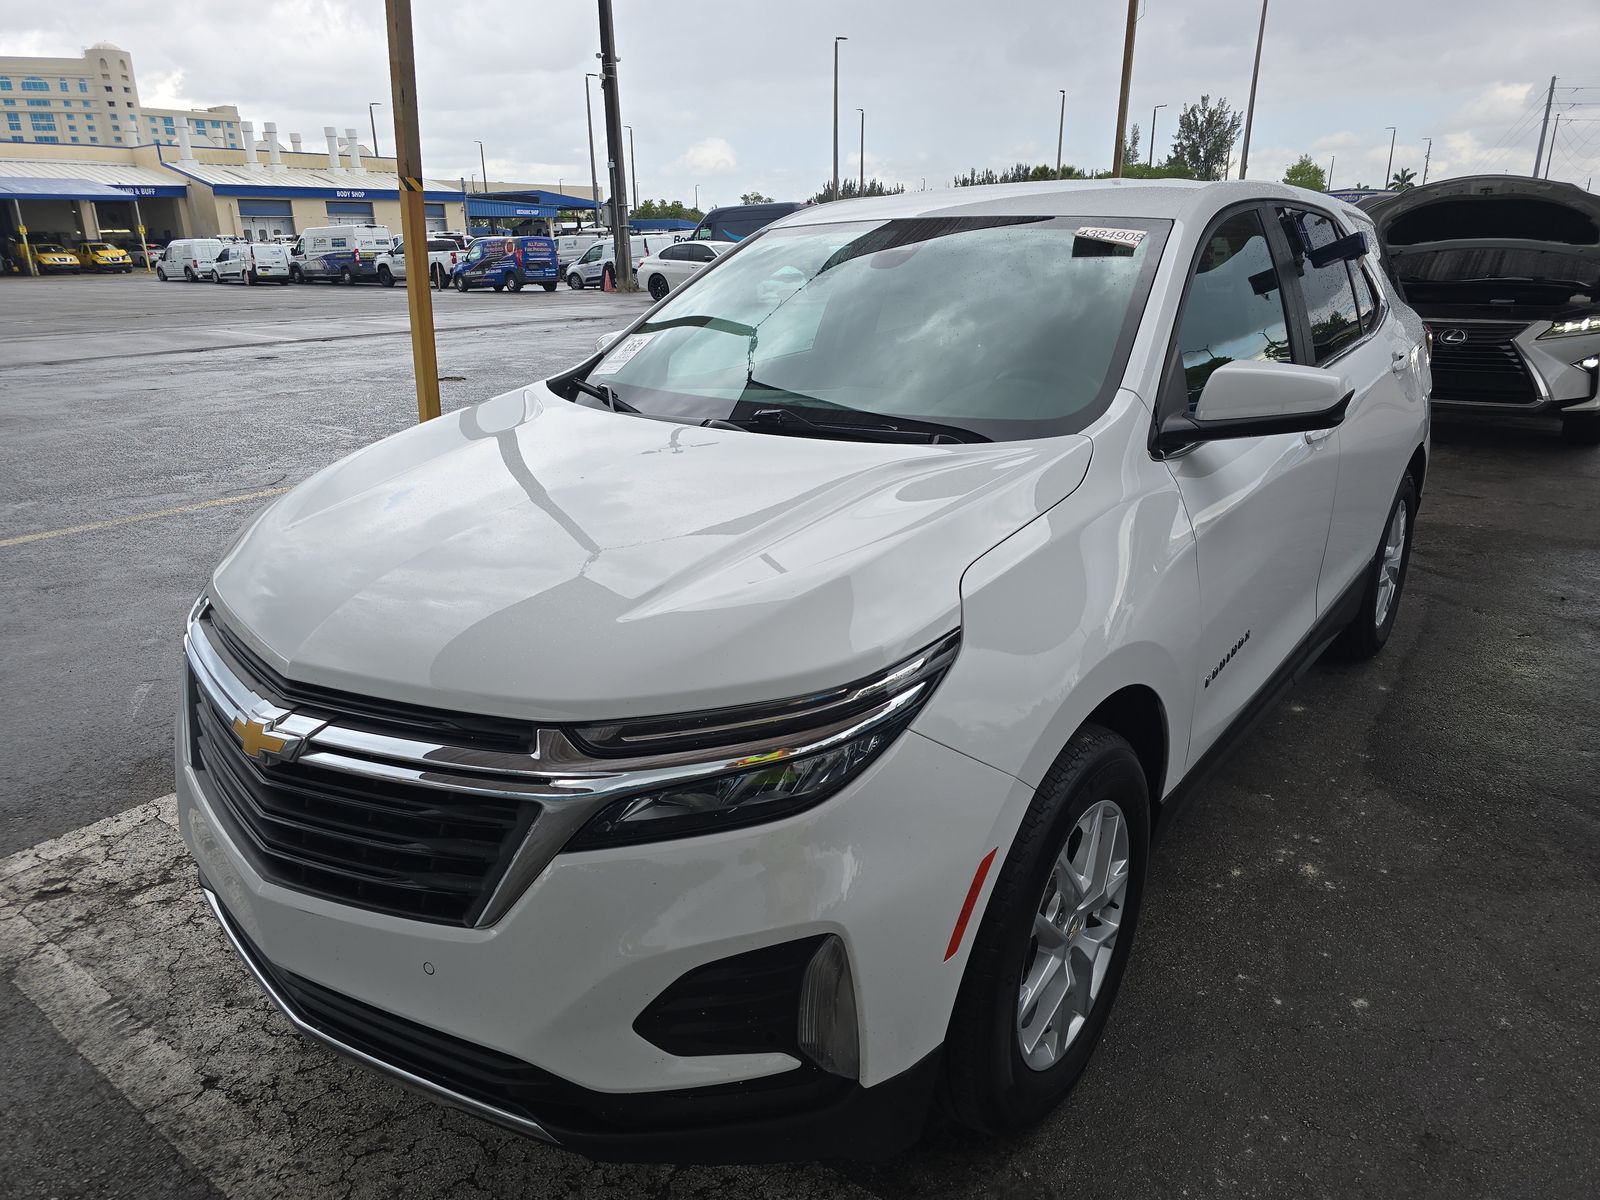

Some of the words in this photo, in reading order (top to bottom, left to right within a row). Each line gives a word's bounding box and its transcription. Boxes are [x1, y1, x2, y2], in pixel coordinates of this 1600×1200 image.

[135, 187, 140, 195] &
[336, 190, 350, 198] BODY
[1078, 229, 1146, 241] 4384908
